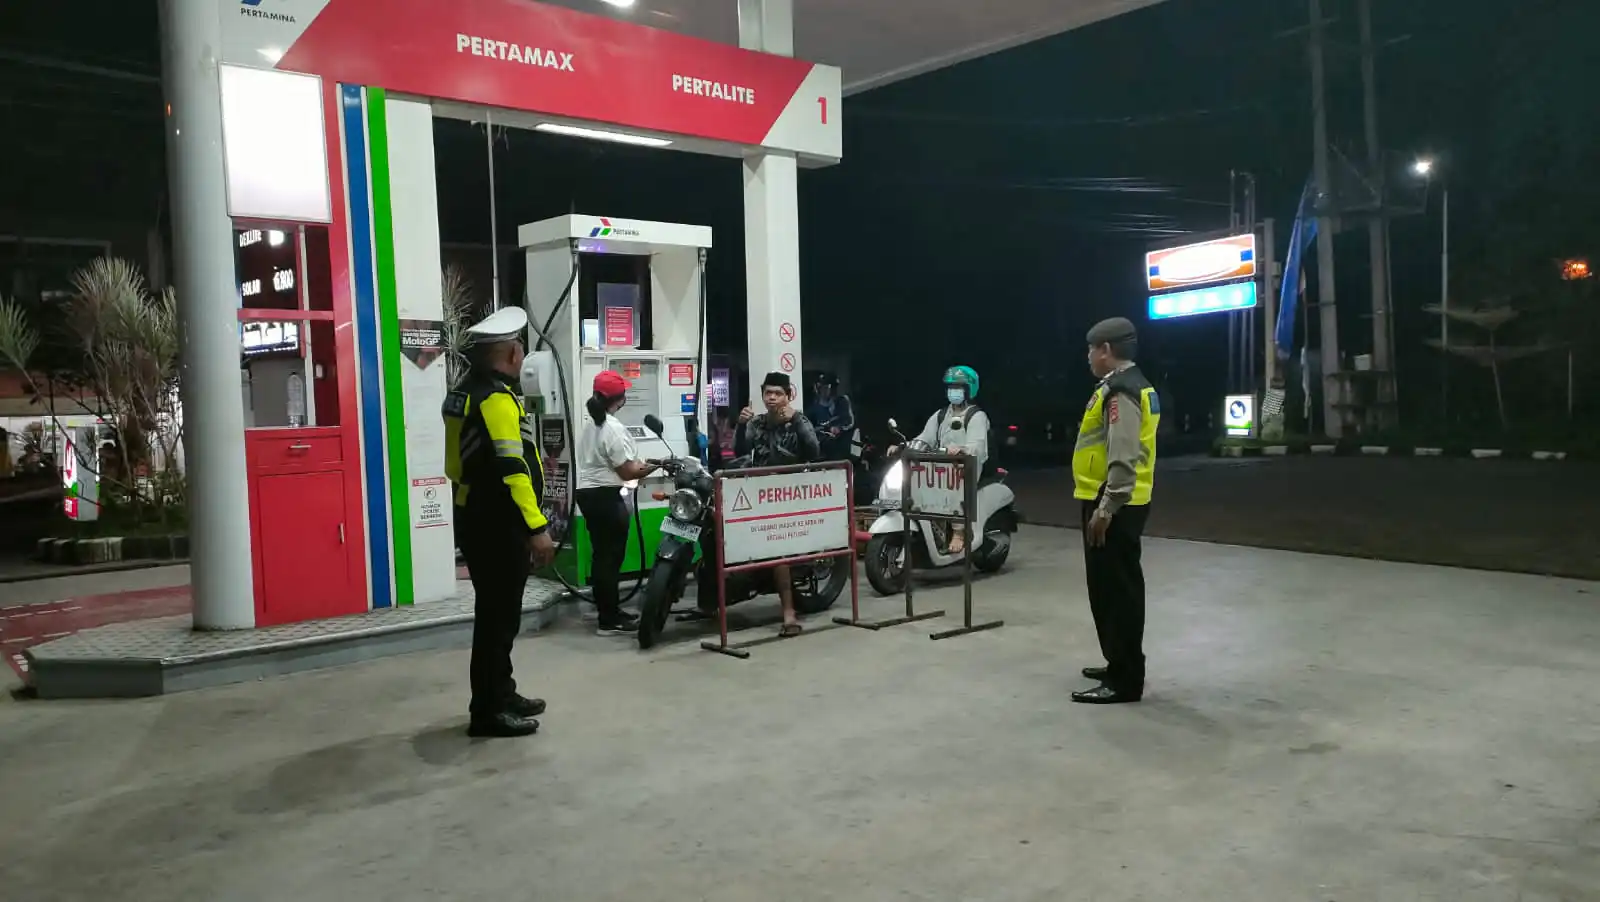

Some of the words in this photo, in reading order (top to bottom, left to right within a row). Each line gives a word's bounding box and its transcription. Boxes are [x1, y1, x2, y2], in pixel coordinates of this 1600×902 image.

[240, 7, 297, 24] PERTAMINA
[456, 33, 575, 72] PERTAMAX
[672, 74, 755, 105] PERTALITE
[817, 96, 828, 125] 1
[402, 336, 439, 346] MotoGP
[758, 482, 833, 505] PERHATIAN
